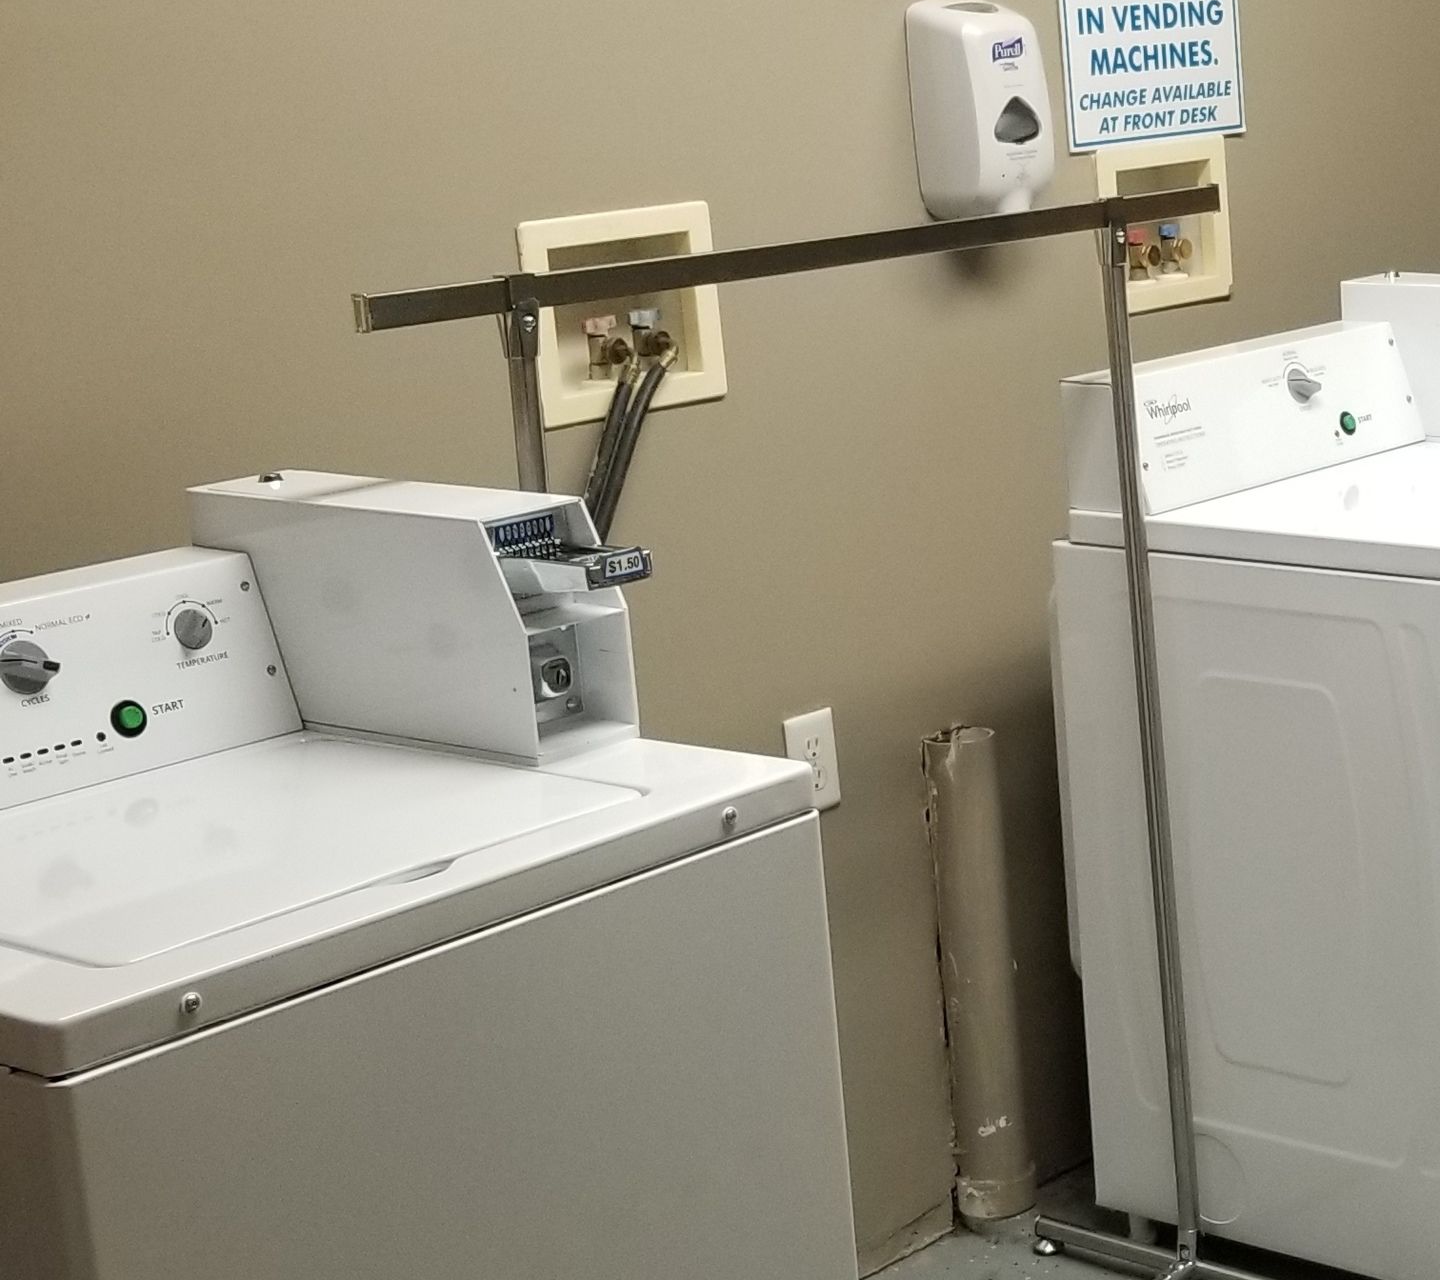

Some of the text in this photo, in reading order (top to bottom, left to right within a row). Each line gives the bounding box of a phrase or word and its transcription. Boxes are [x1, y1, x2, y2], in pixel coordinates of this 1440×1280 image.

[1077, 0, 1224, 35] IN VENDING
[1091, 40, 1219, 76] MACHINES.
[1080, 80, 1232, 111] CHANGE AVAILABLE
[1099, 105, 1218, 134] AT FRONT DESK
[1146, 398, 1191, 419] Whirlpool
[608, 555, 640, 574] $1.50
[176, 651, 228, 669] TEMPERATURE
[21, 694, 50, 708] CYCLES
[152, 699, 184, 715] START
